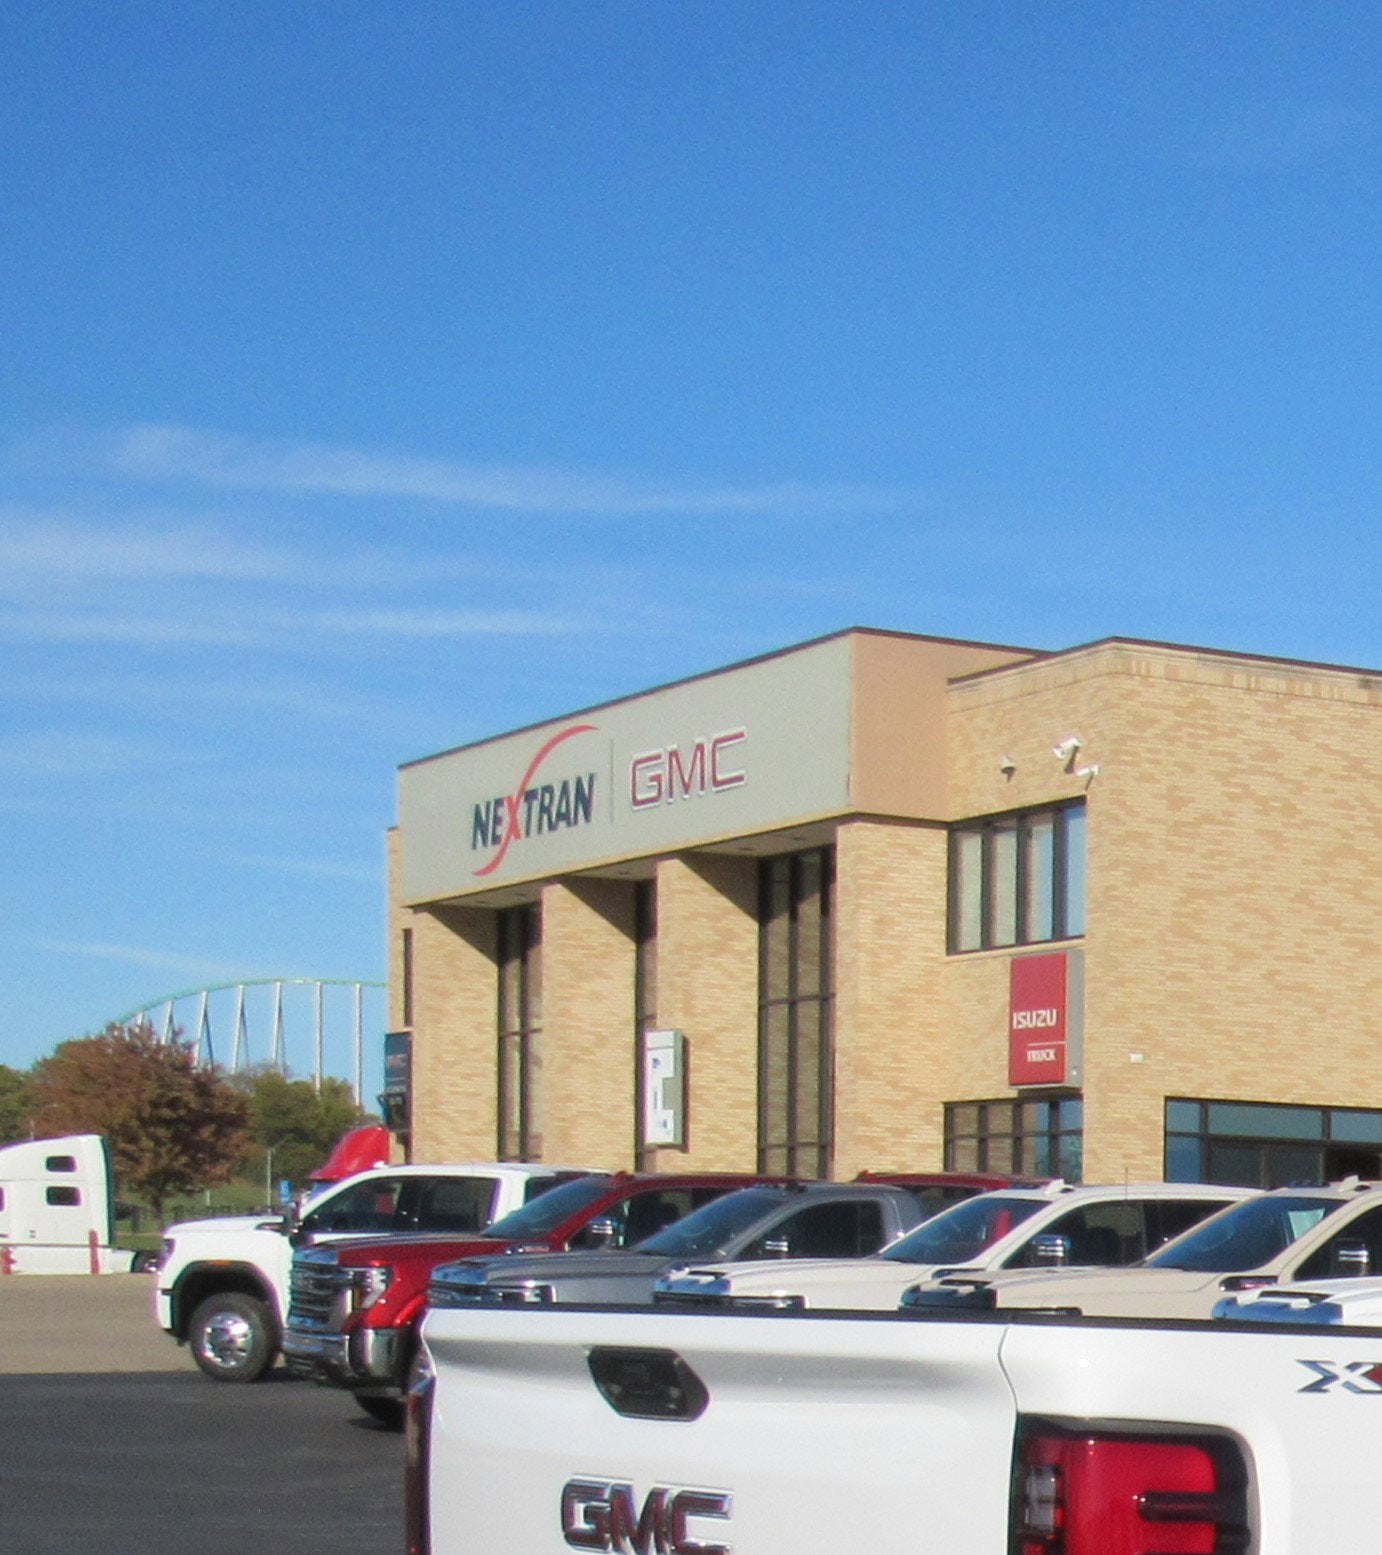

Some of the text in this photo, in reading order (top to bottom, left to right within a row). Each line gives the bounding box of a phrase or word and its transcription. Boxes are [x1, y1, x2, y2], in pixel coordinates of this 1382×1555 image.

[471, 726, 749, 851] NEXTRAN GMC
[1013, 1008, 1057, 1029] ISUZU
[1026, 1049, 1056, 1063] TRUCK
